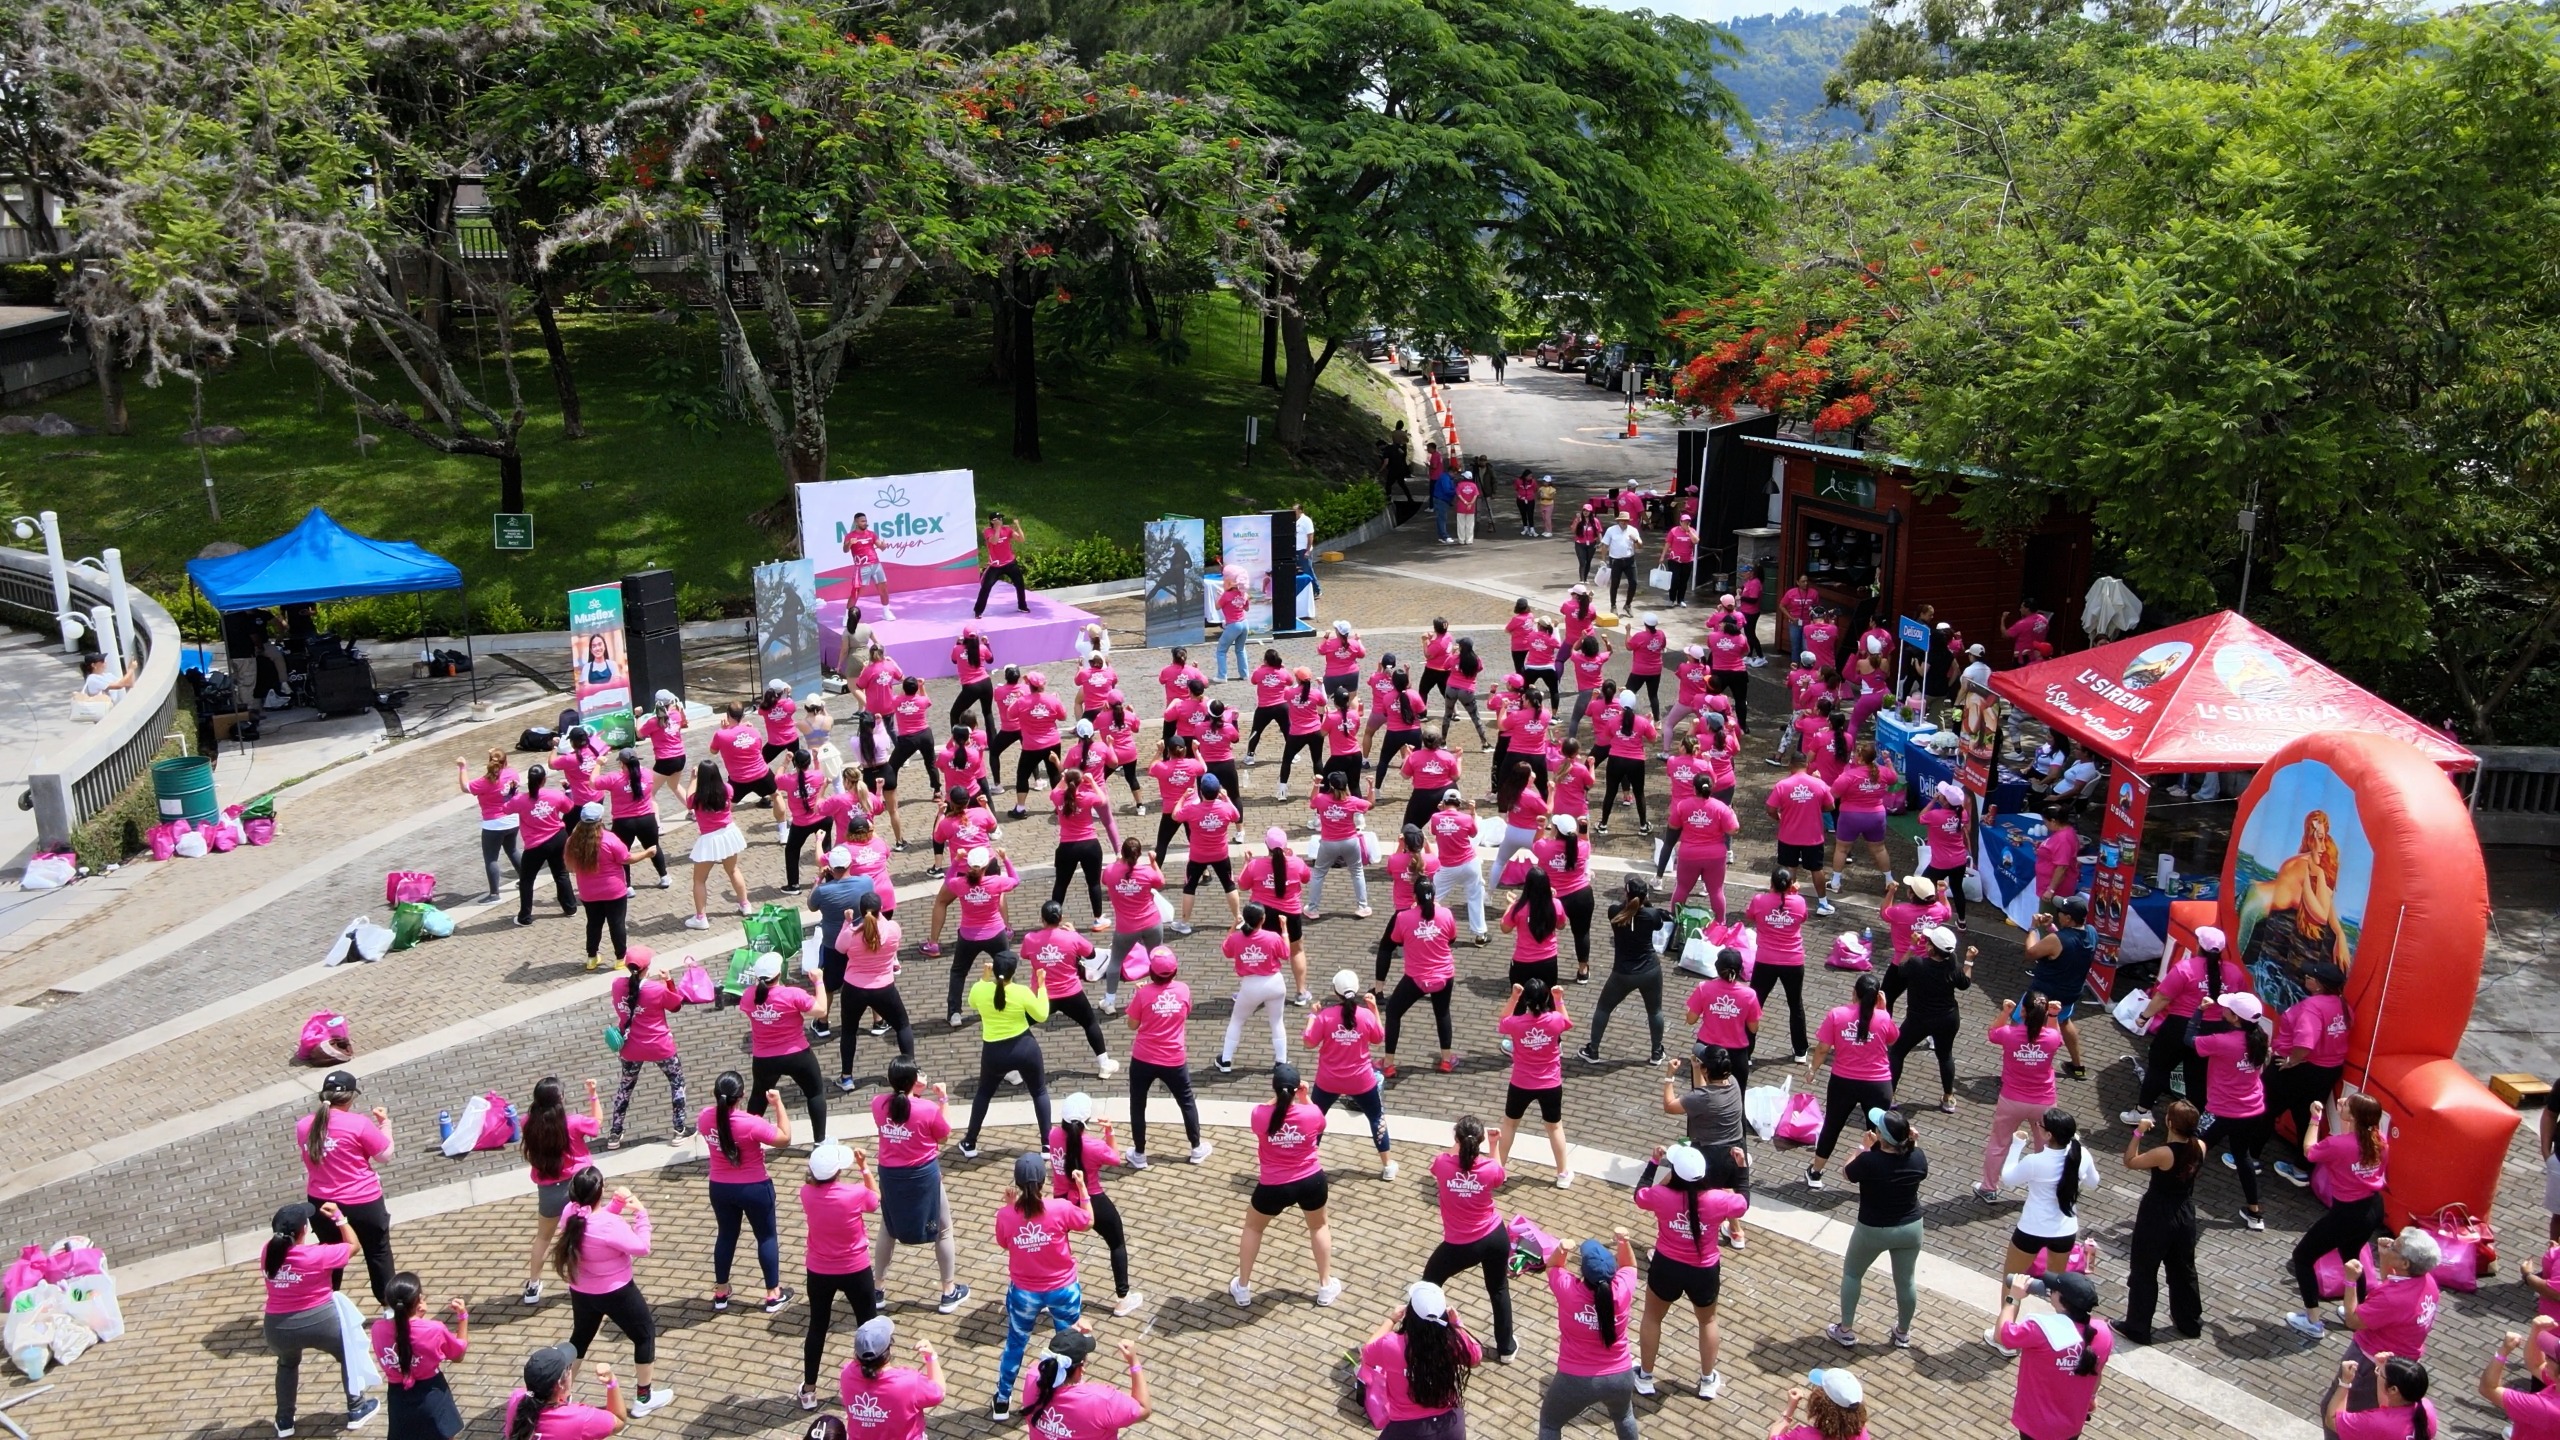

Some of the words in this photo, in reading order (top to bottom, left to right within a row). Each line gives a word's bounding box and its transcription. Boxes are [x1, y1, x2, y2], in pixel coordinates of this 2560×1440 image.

[574, 609, 615, 624] Musflex
[2076, 668, 2099, 684] LA
[2089, 678, 2154, 714] SIRENA
[2196, 703, 2219, 720] LA
[2222, 704, 2343, 721] SIRENA
[1710, 1003, 1740, 1014] Musflex
[2013, 1050, 2048, 1060] Musflex
[881, 1125, 912, 1137] Musflex
[1268, 1131, 1306, 1142] Musflex
[1446, 1178, 1484, 1191] Musflex
[1013, 1233, 1052, 1246] Musflex
[848, 1404, 889, 1419] Musflex
